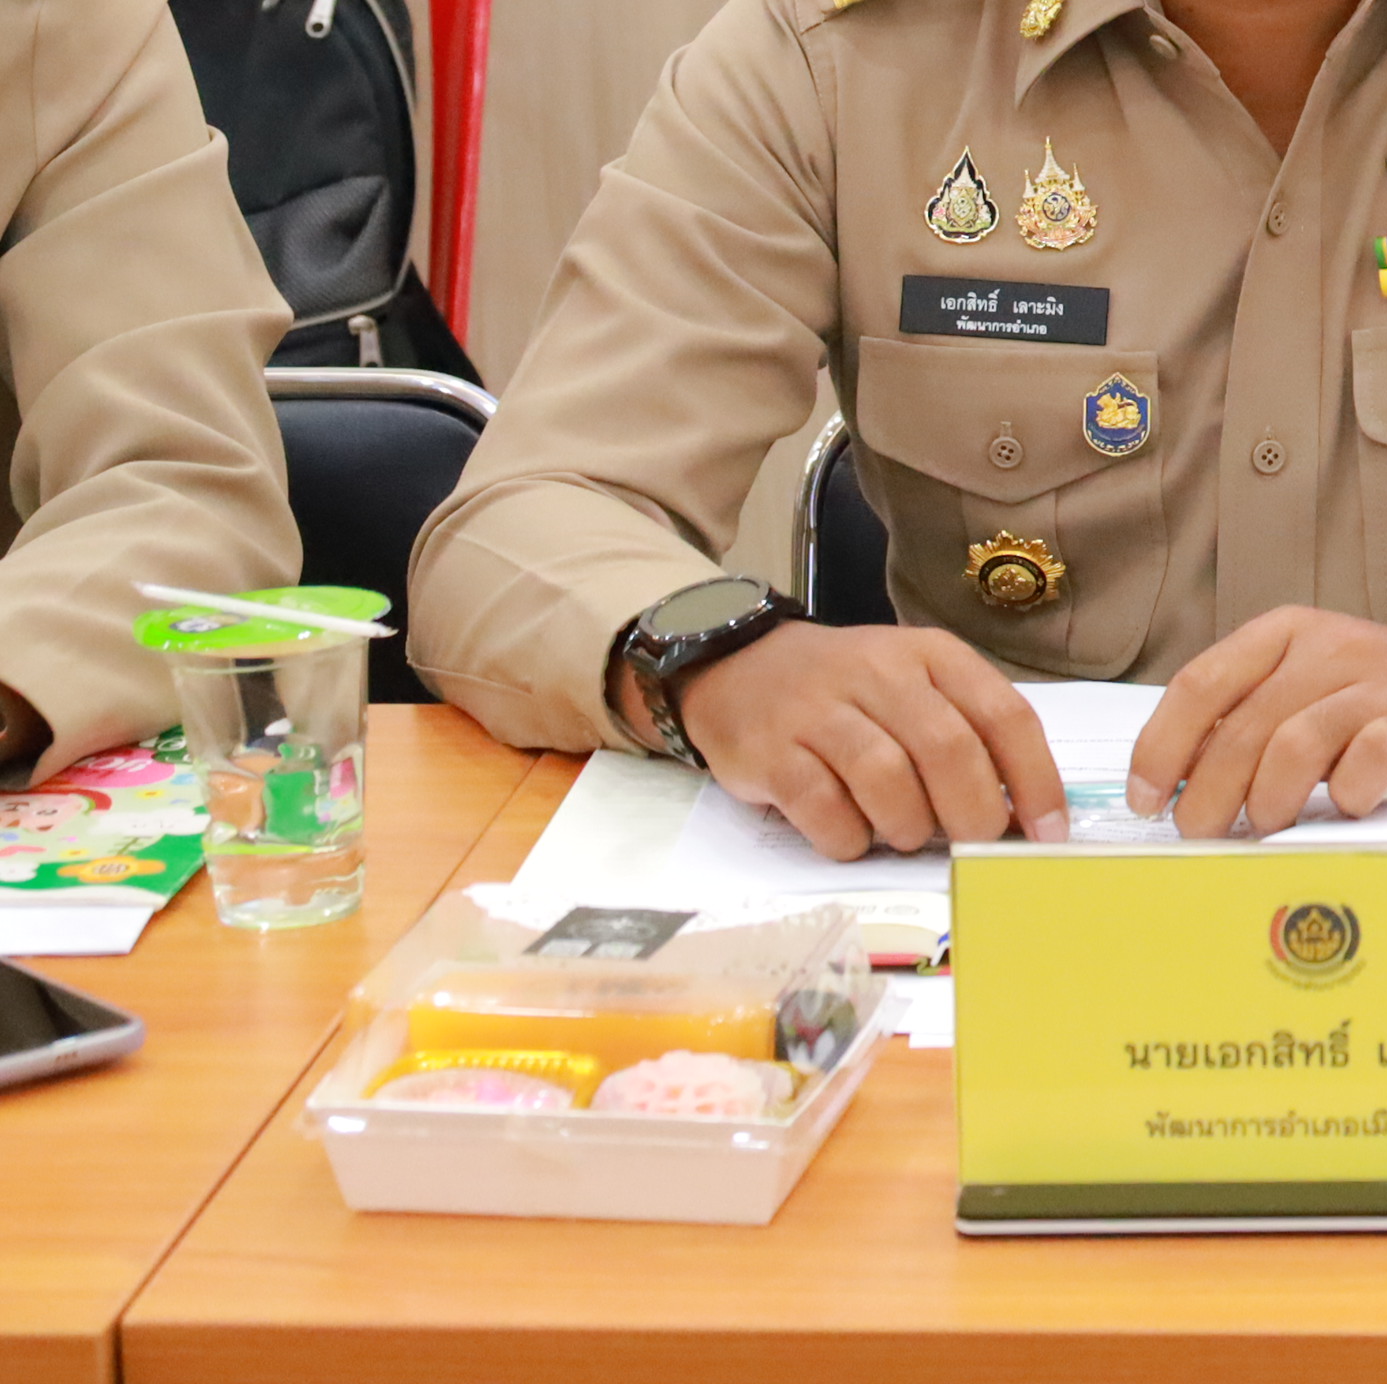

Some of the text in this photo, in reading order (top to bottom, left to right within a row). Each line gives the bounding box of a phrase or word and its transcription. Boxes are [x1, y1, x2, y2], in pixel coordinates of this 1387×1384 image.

[940, 288, 1064, 316] เอกสิทธิ์ เลาะมิง
[955, 315, 1048, 335] พัฒนาการอำเภอ
[1123, 1018, 1352, 1070] นายเอกสิทธิ์
